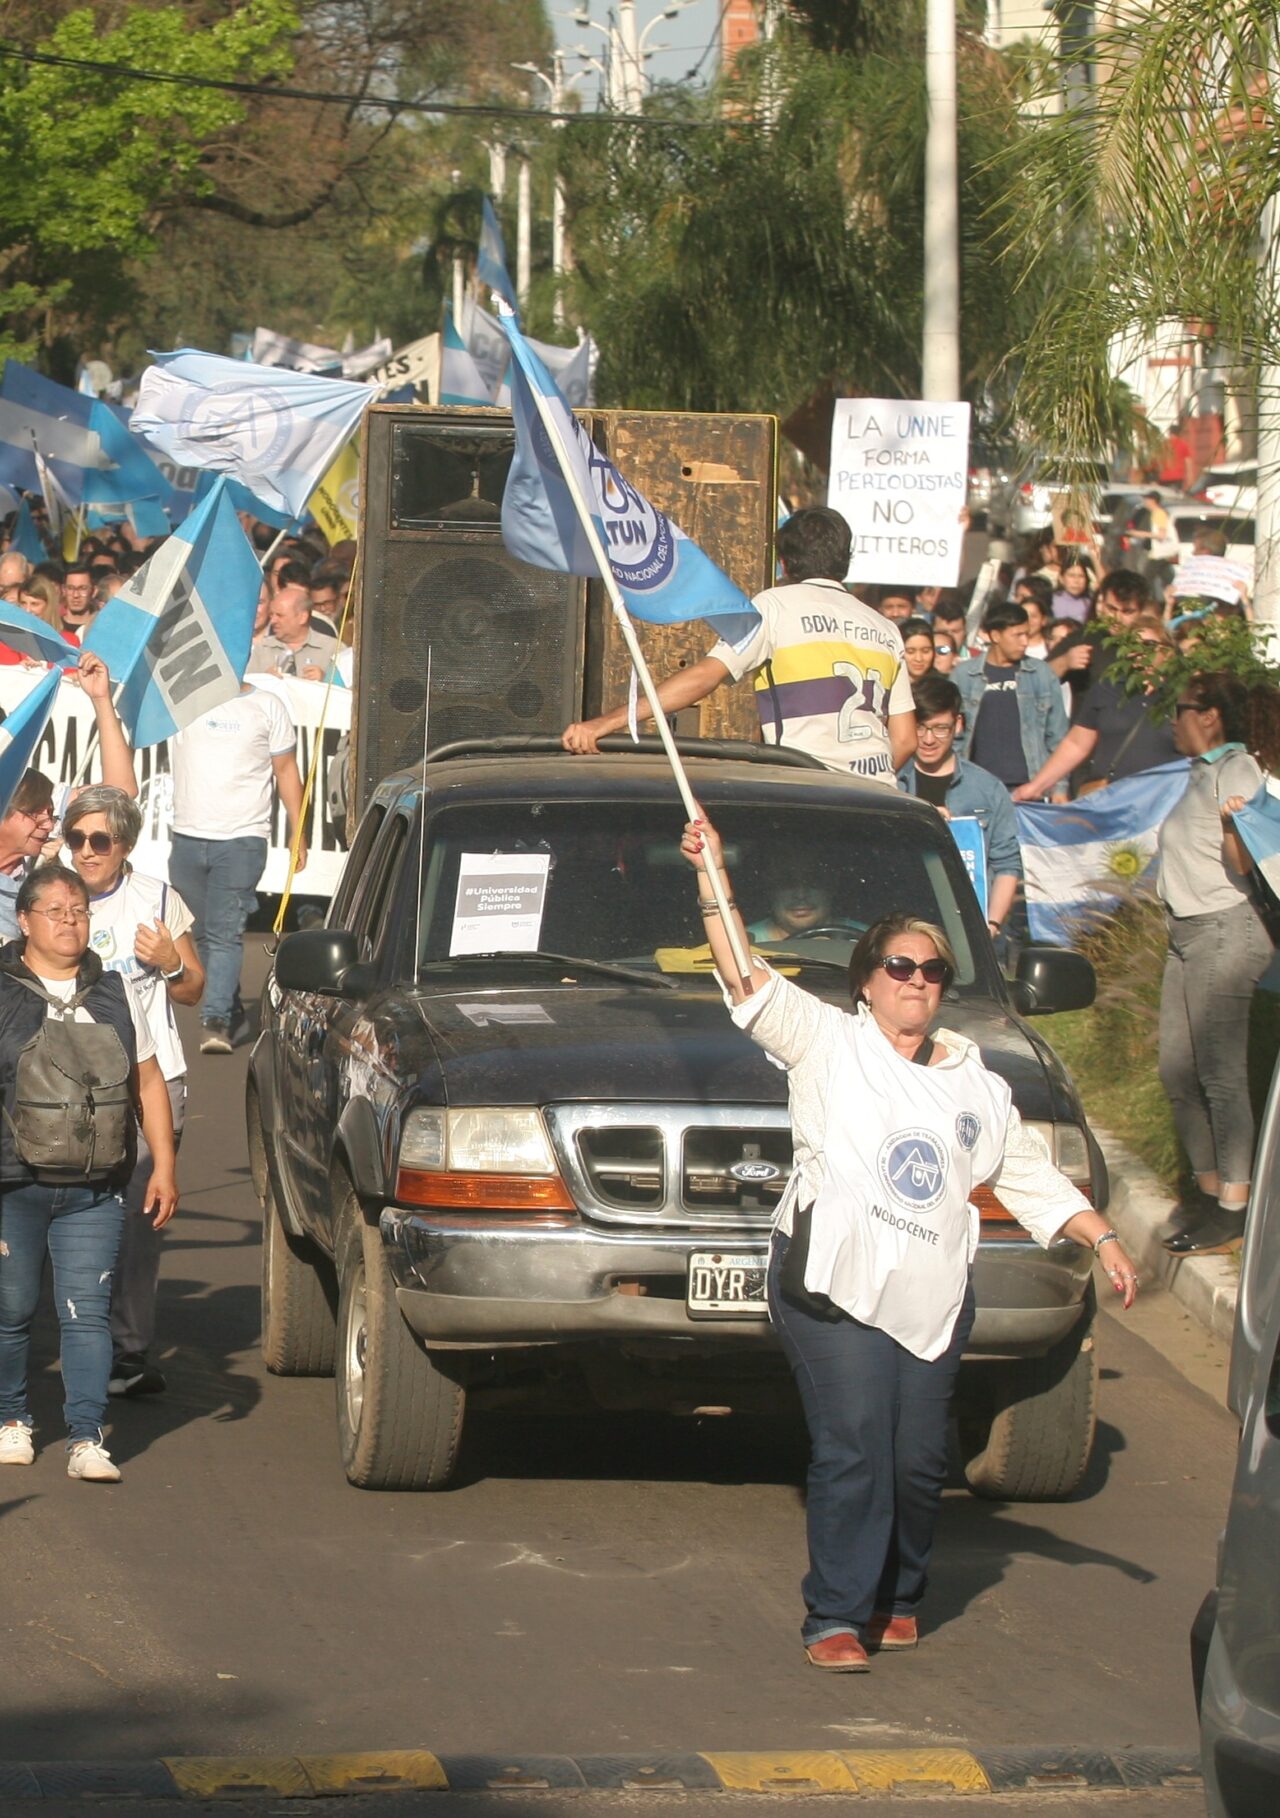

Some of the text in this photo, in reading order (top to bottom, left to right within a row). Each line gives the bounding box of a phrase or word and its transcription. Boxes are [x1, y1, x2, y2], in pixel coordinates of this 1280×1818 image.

[847, 415, 956, 439] LA UNNE
[862, 448, 930, 467] FORMA
[837, 470, 963, 492] PERIODISTAS
[873, 499, 914, 525] NO
[800, 615, 840, 634] BBVA
[465, 886, 538, 896] #Universidad
[480, 894, 521, 903] Pública
[477, 902, 522, 911] Siempre
[741, 1164, 770, 1178] Ford
[871, 1204, 940, 1246] NODOCENTE
[729, 1256, 768, 1266] ARGENTI
[695, 1268, 745, 1300] DYR
